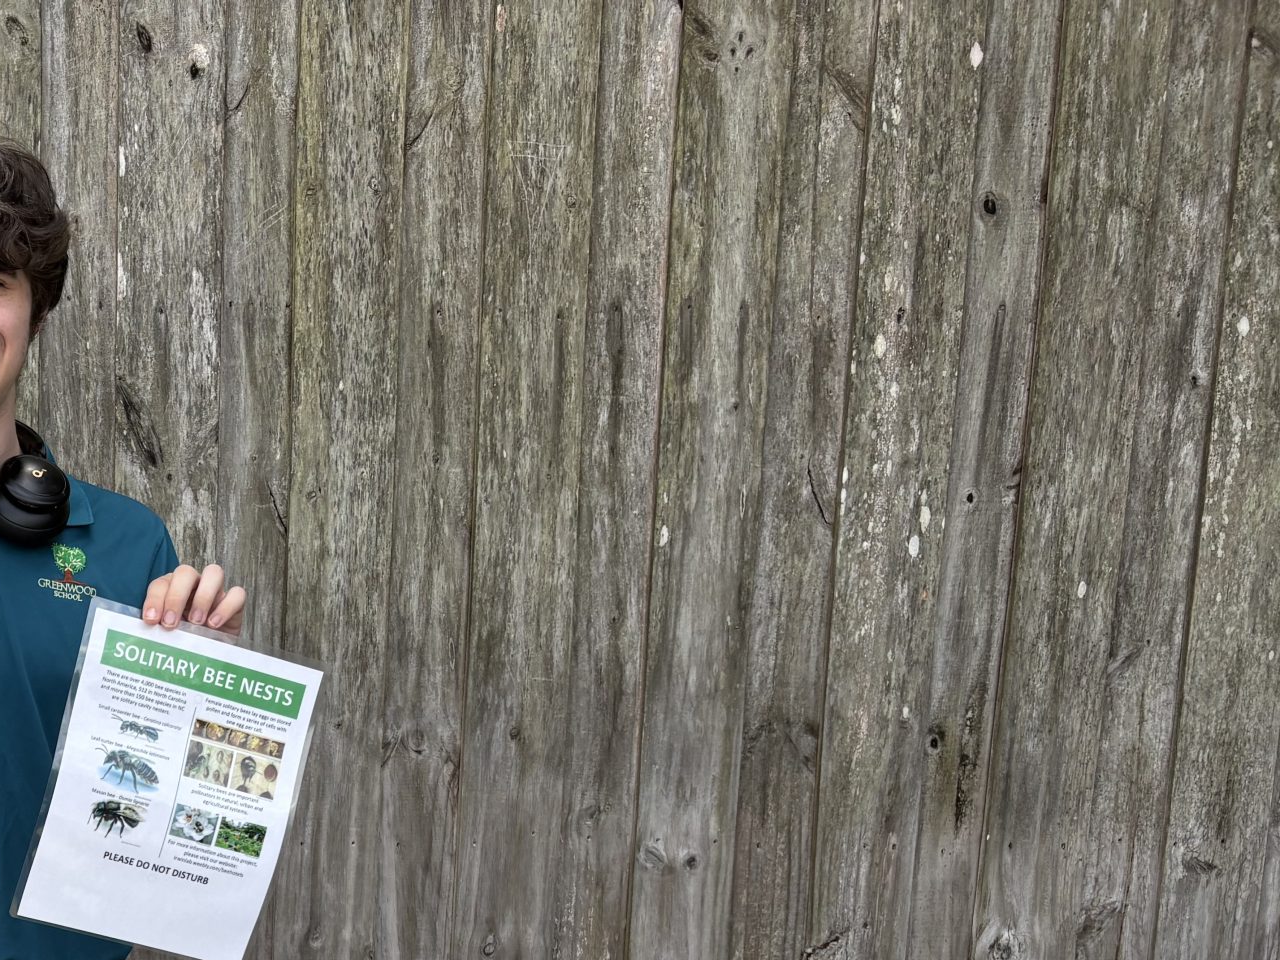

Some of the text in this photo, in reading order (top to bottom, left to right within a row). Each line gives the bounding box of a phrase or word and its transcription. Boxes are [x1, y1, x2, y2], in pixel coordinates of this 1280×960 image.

[38, 578, 96, 597] GREENWOOD
[54, 590, 82, 602] SCHOOL
[113, 642, 294, 706] SOLITARY BEE NESTS
[124, 690, 135, 698] than
[154, 698, 172, 708] species
[104, 851, 209, 885] PLEASE DO NOT DISTURB
